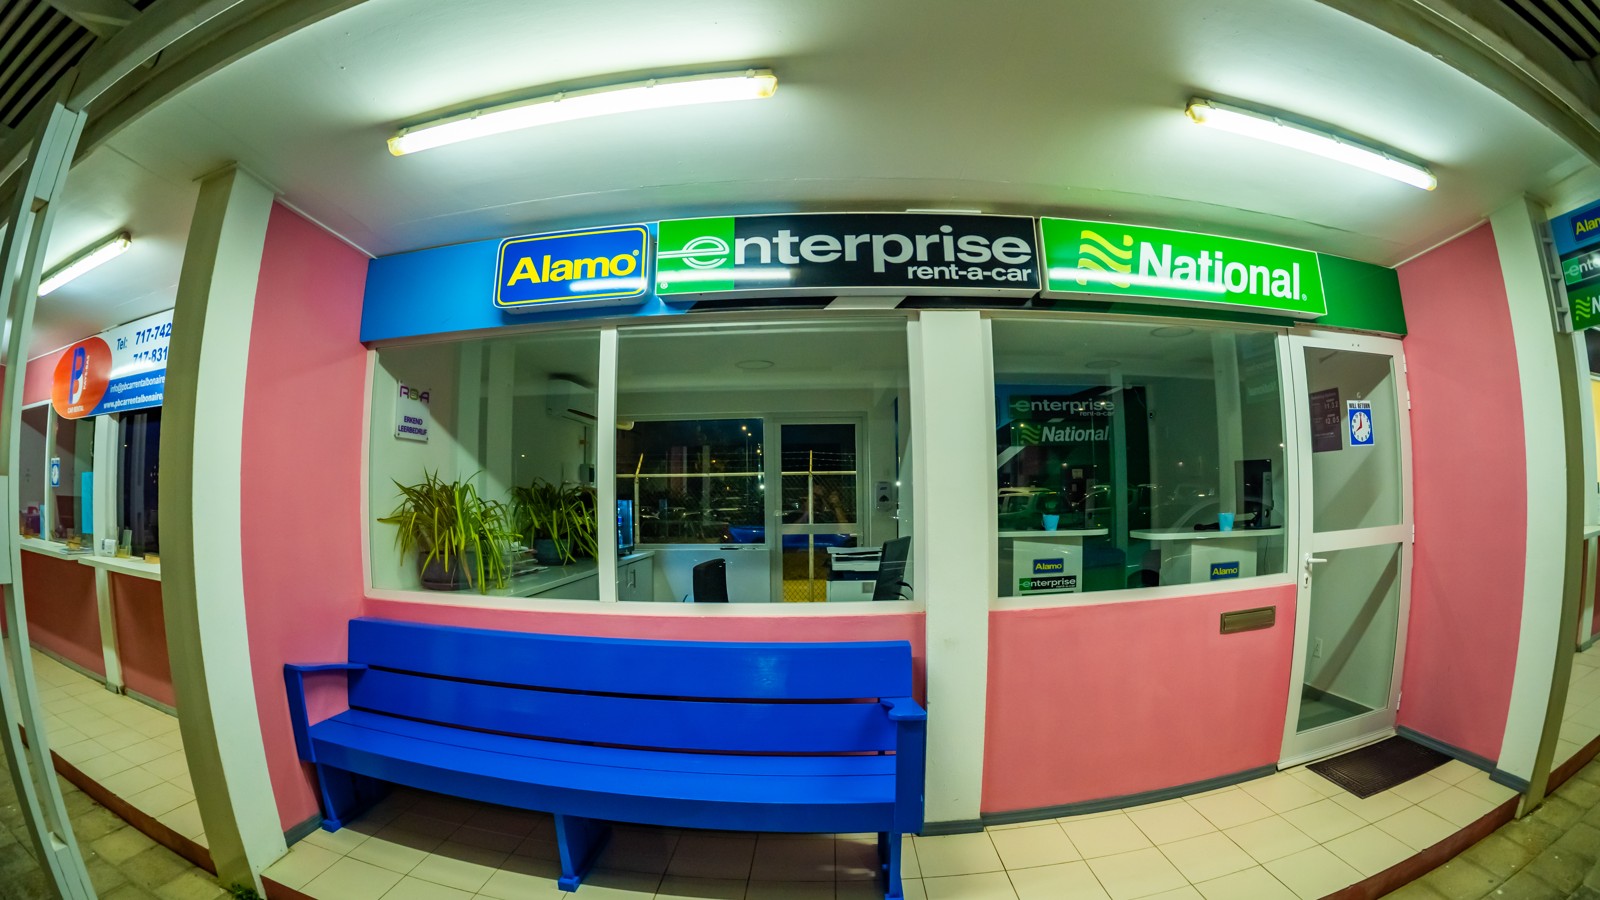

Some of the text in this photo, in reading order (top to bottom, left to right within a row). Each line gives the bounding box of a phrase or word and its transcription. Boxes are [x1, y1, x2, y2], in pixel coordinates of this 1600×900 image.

[658, 225, 1032, 273] enterprise
[507, 253, 637, 286] Alamo
[907, 264, 1031, 282] rent-a-car
[1138, 241, 1301, 301] National
[116, 336, 128, 351] Tel:
[1010, 398, 1115, 414] enterprise
[1041, 425, 1109, 442] National
[1035, 562, 1063, 571] Alamo
[1212, 567, 1238, 576] Alamo
[1020, 577, 1077, 588] enterprise
